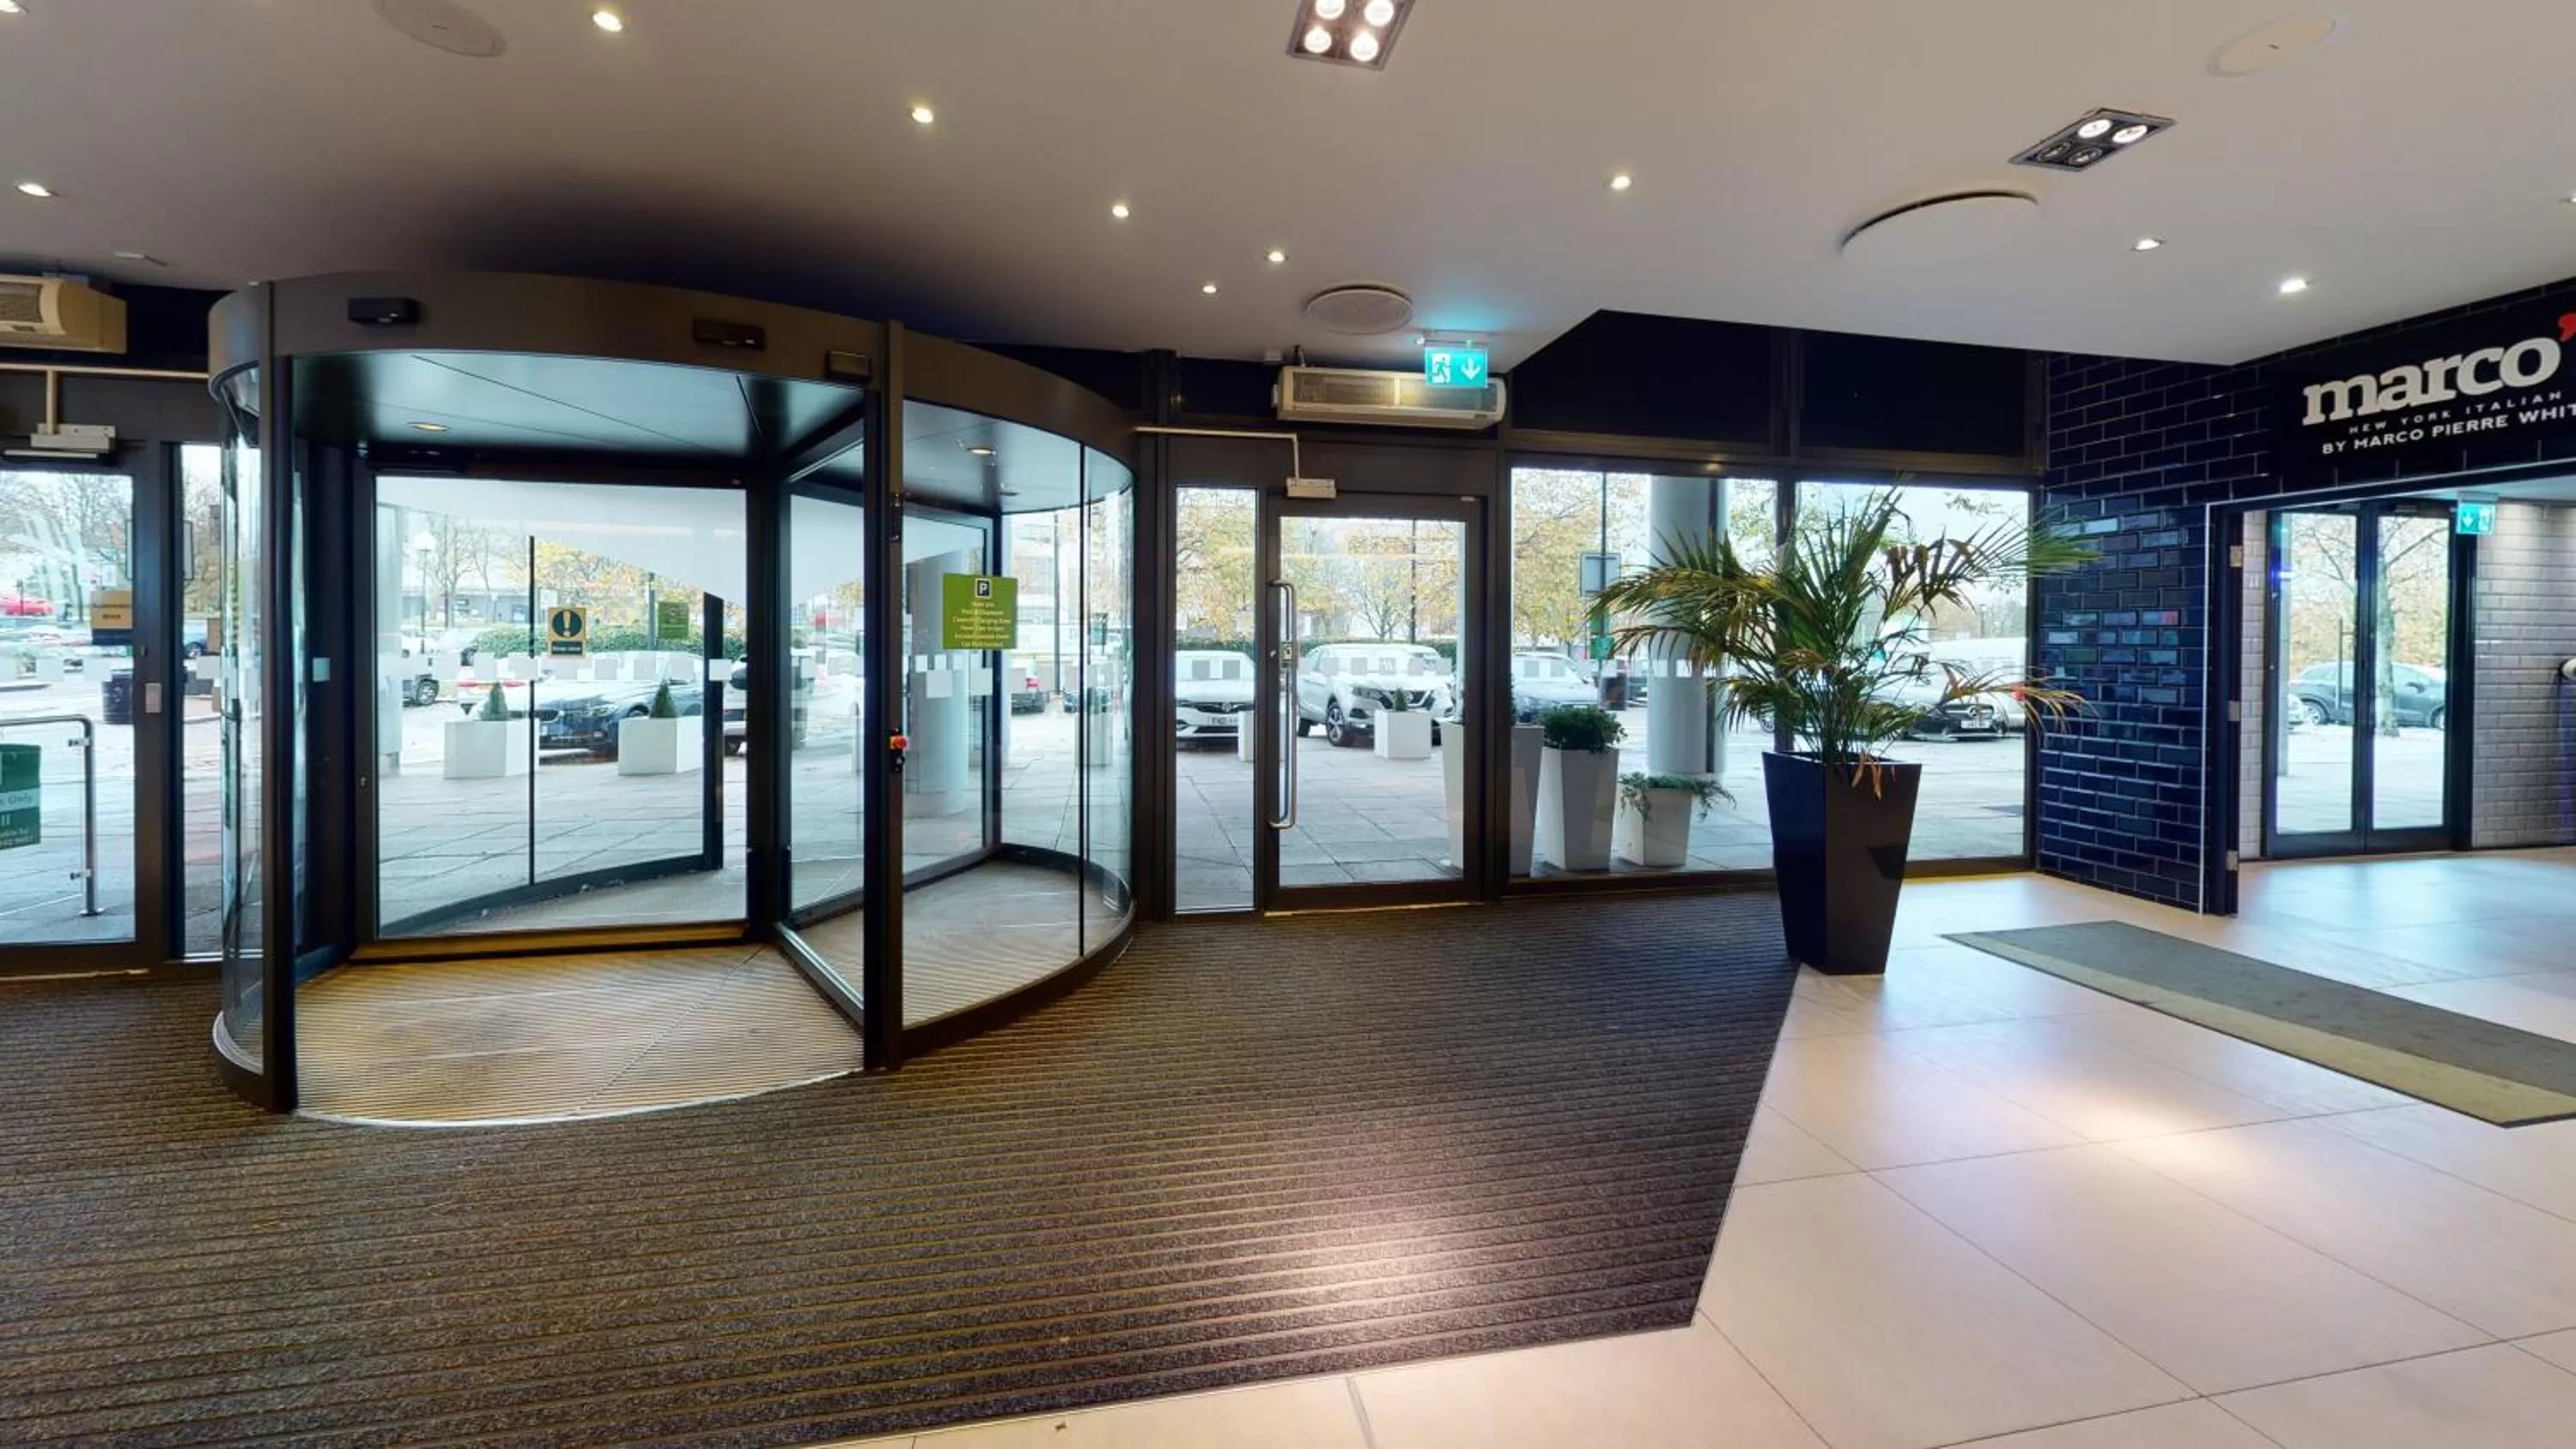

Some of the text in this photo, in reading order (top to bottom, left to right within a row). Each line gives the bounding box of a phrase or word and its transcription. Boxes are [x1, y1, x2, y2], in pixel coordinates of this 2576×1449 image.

[2348, 390, 2562, 434] NEW YORK ITALIAN
[2322, 440, 2347, 455] BY
[2354, 428, 2425, 451] MARCO
[2432, 414, 2509, 439] PIERRE
[979, 582, 987, 594] P
